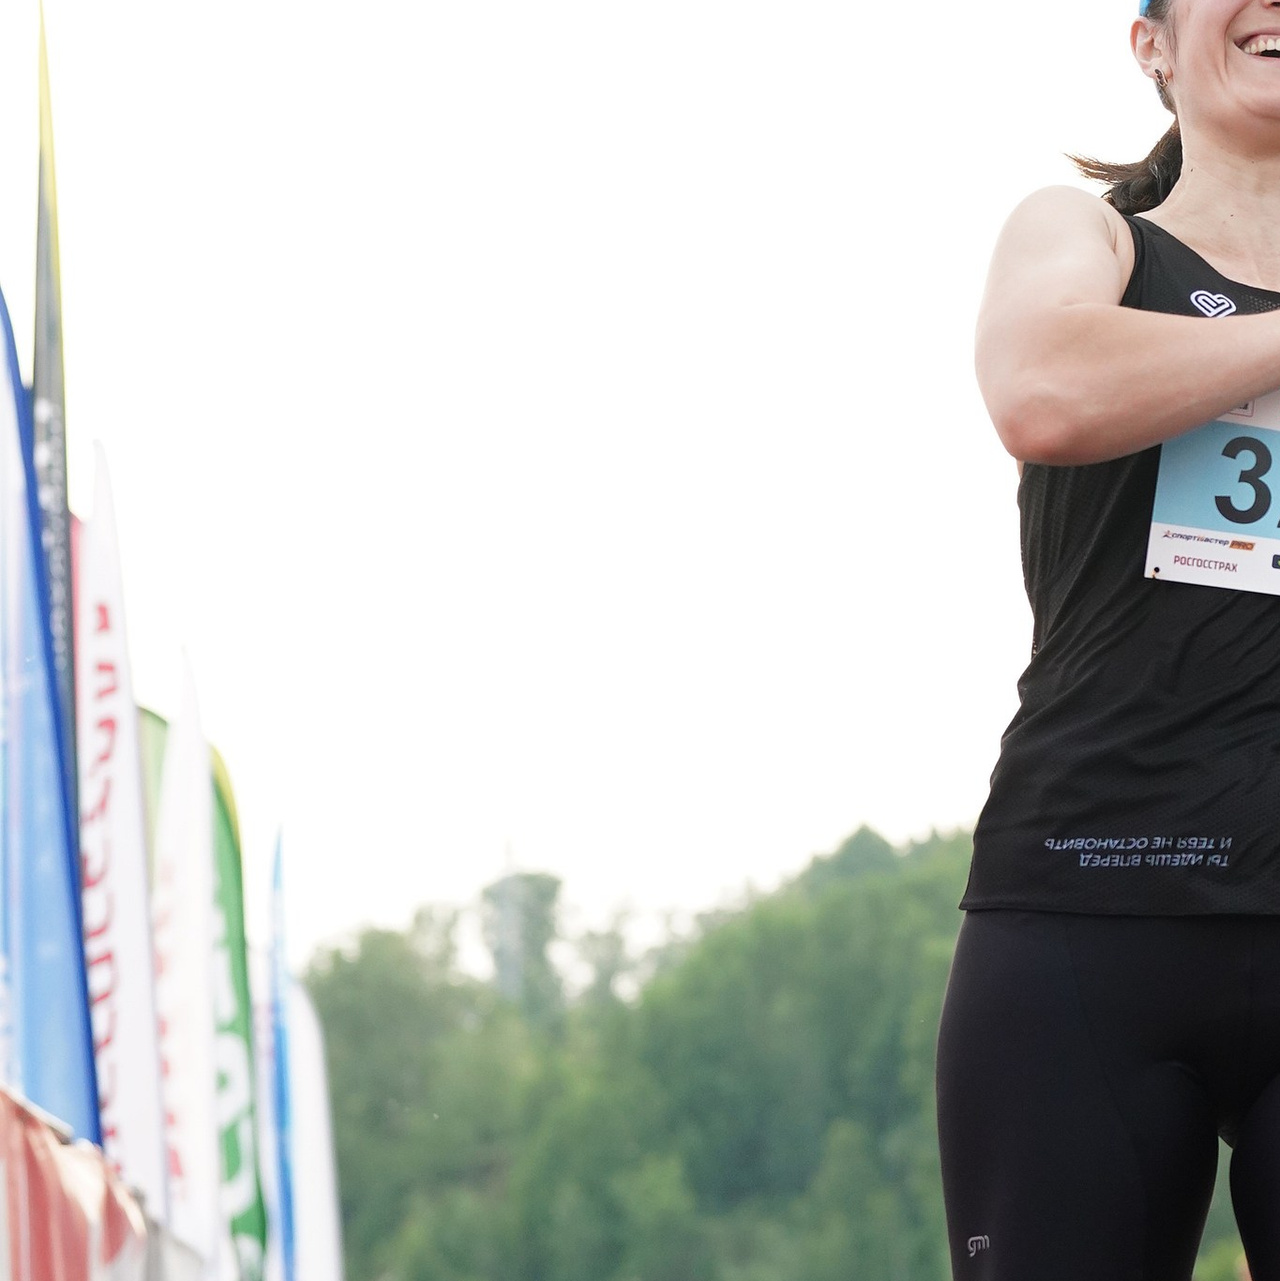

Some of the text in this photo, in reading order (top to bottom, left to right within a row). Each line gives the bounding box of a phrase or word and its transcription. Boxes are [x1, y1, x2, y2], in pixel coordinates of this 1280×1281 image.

[1230, 540, 1254, 550] PRO
[1173, 555, 1238, 572] РОСГОССТРАХ
[1044, 836, 1233, 851] И ТЕБЯ НЕ ОСТАНОВИТЬ
[1079, 852, 1230, 867] ТЫ ИДЕШЬ ВПЕРЕД
